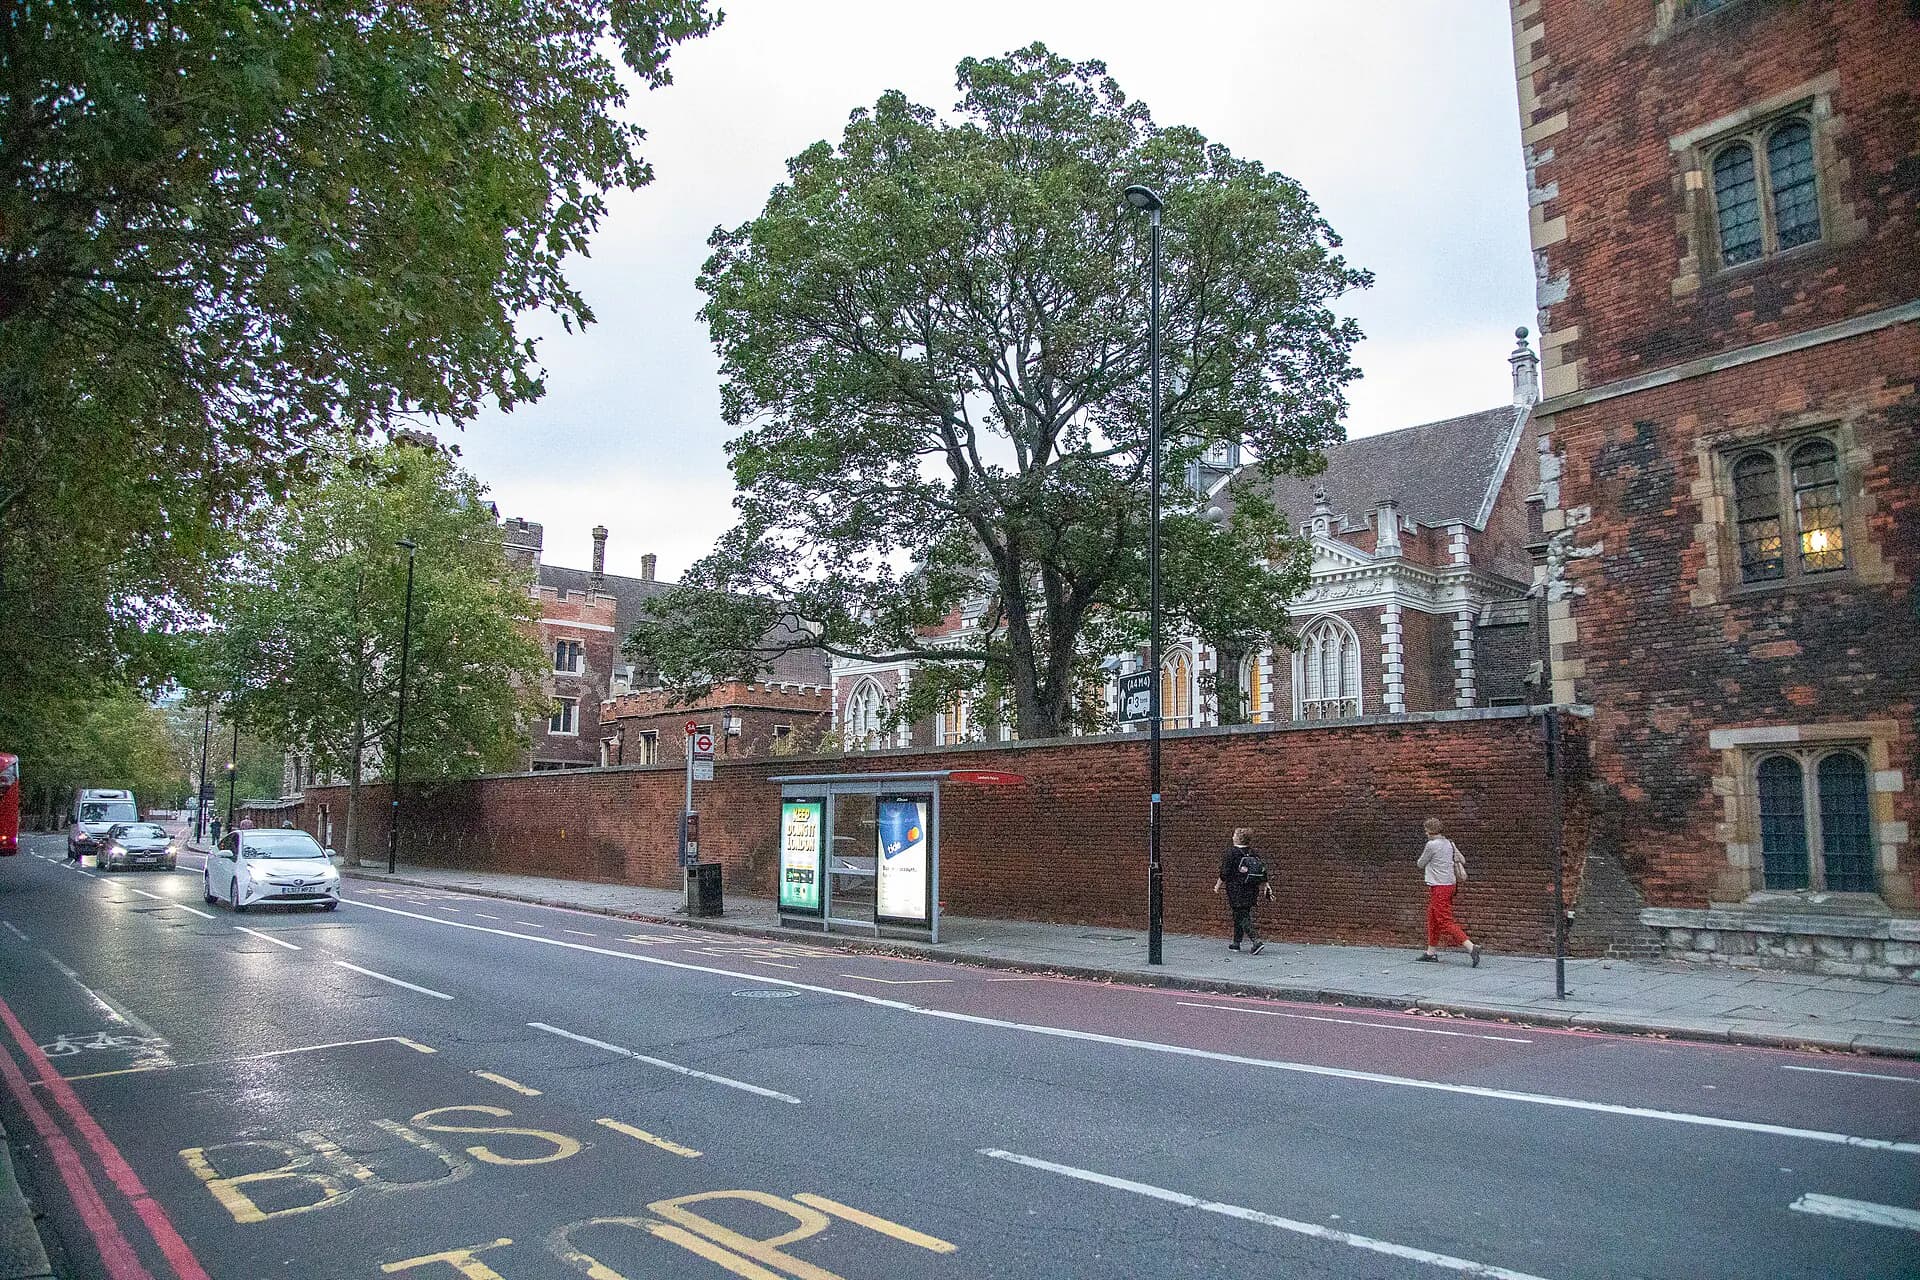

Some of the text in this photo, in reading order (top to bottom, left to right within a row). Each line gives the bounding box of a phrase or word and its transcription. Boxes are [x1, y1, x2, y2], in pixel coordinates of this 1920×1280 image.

[1134, 696, 1139, 708] 3
[787, 837, 816, 852] LONDON
[888, 841, 901, 854] tide
[178, 1105, 582, 1223] BUS
